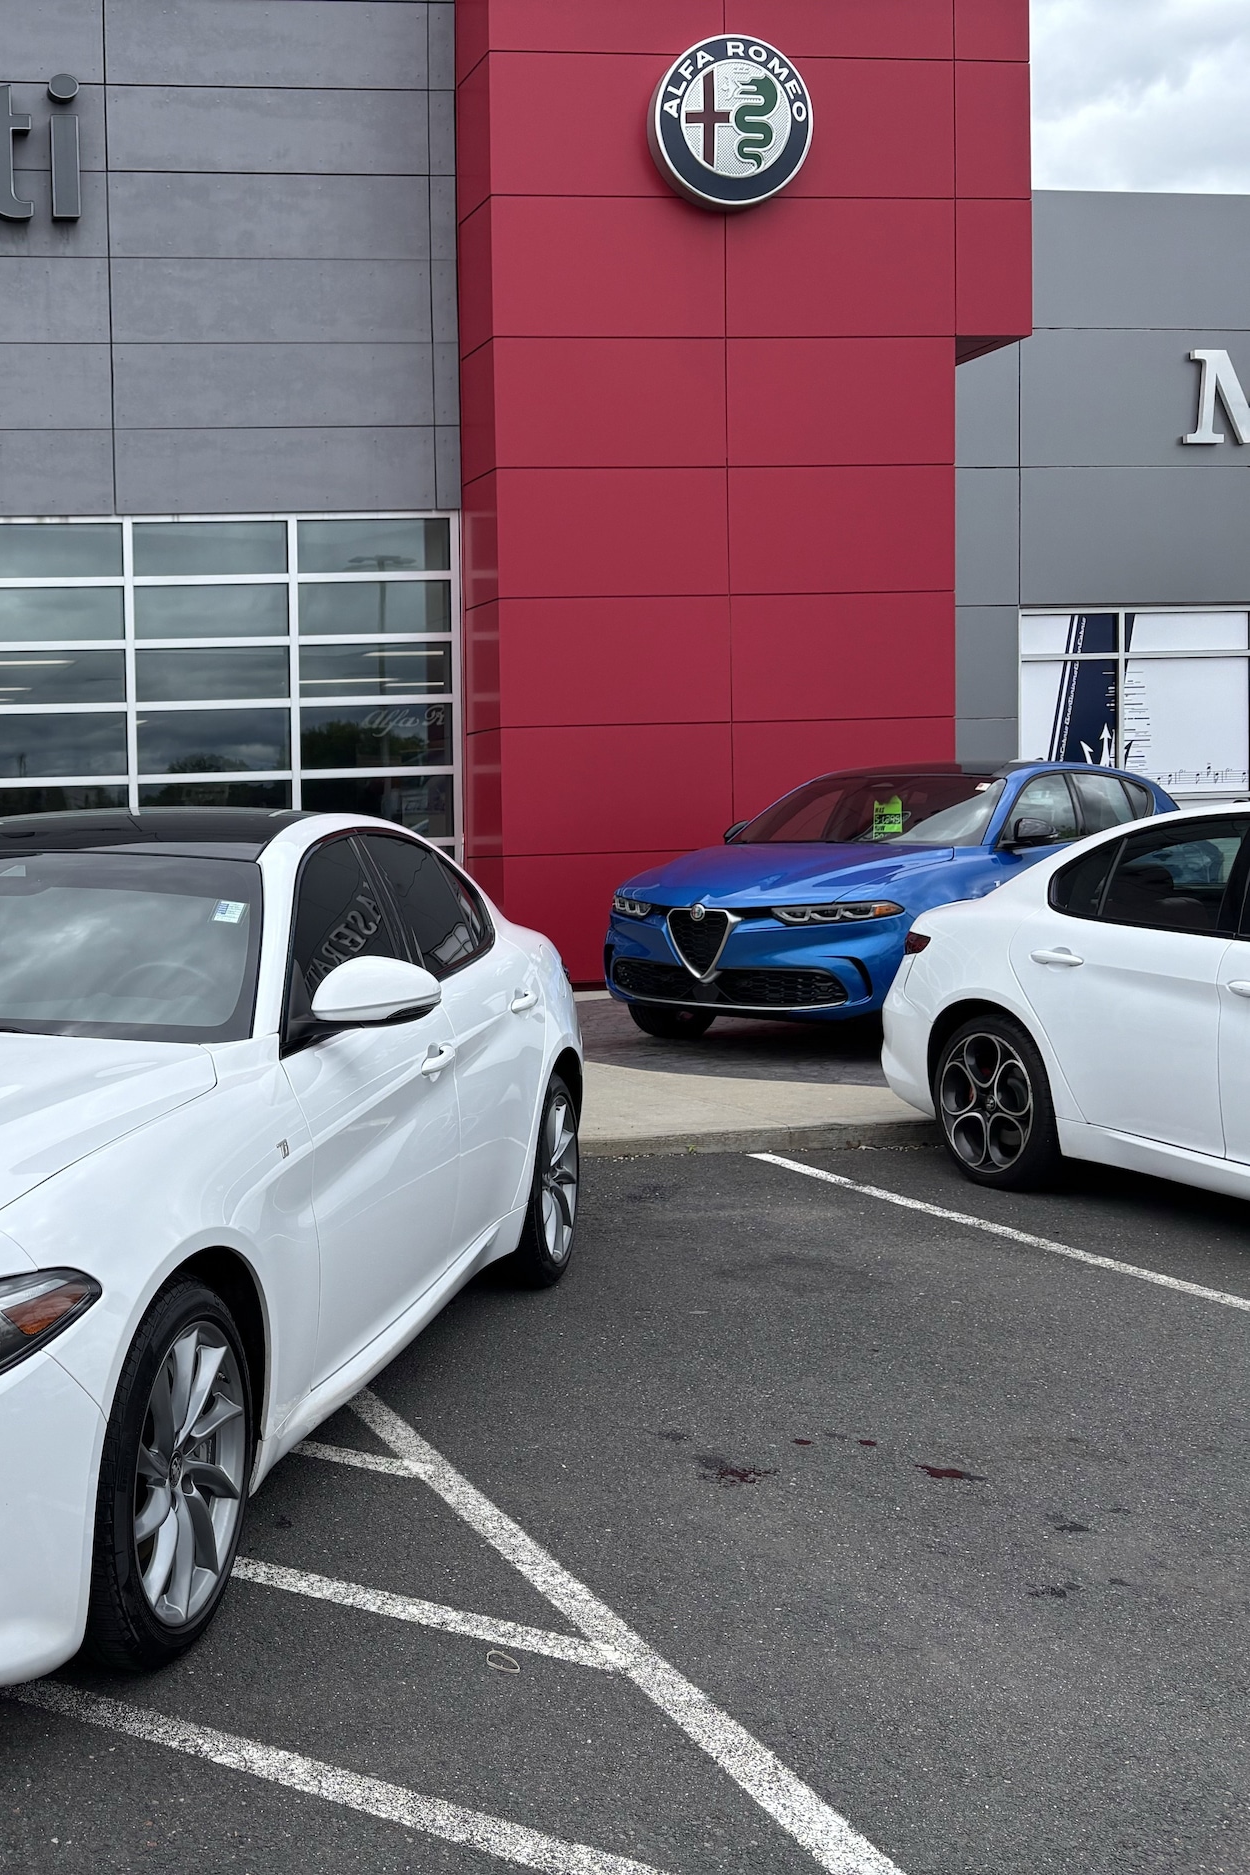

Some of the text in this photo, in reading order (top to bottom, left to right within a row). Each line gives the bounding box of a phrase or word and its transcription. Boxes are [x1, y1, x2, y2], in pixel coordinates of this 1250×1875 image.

[663, 41, 807, 122] ALFA ROMEO
[360, 708, 420, 738] Alfa
